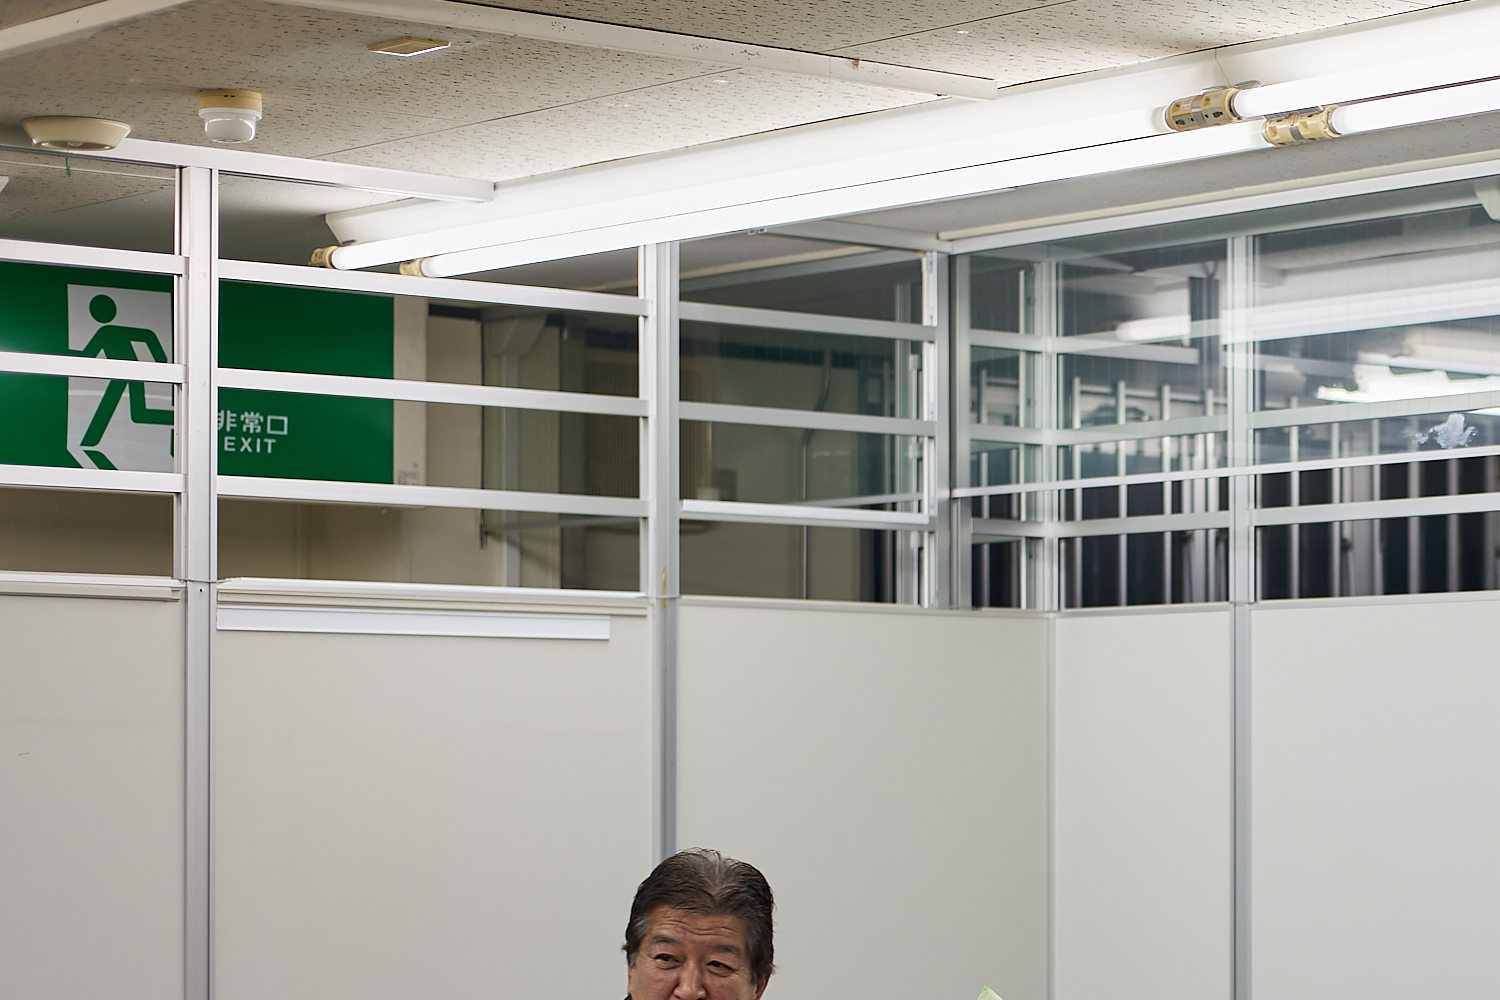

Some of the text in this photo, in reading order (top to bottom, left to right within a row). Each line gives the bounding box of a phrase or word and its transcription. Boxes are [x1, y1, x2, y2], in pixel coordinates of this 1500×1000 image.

[217, 409, 289, 436] 非常口
[223, 436, 277, 454] EXIT
